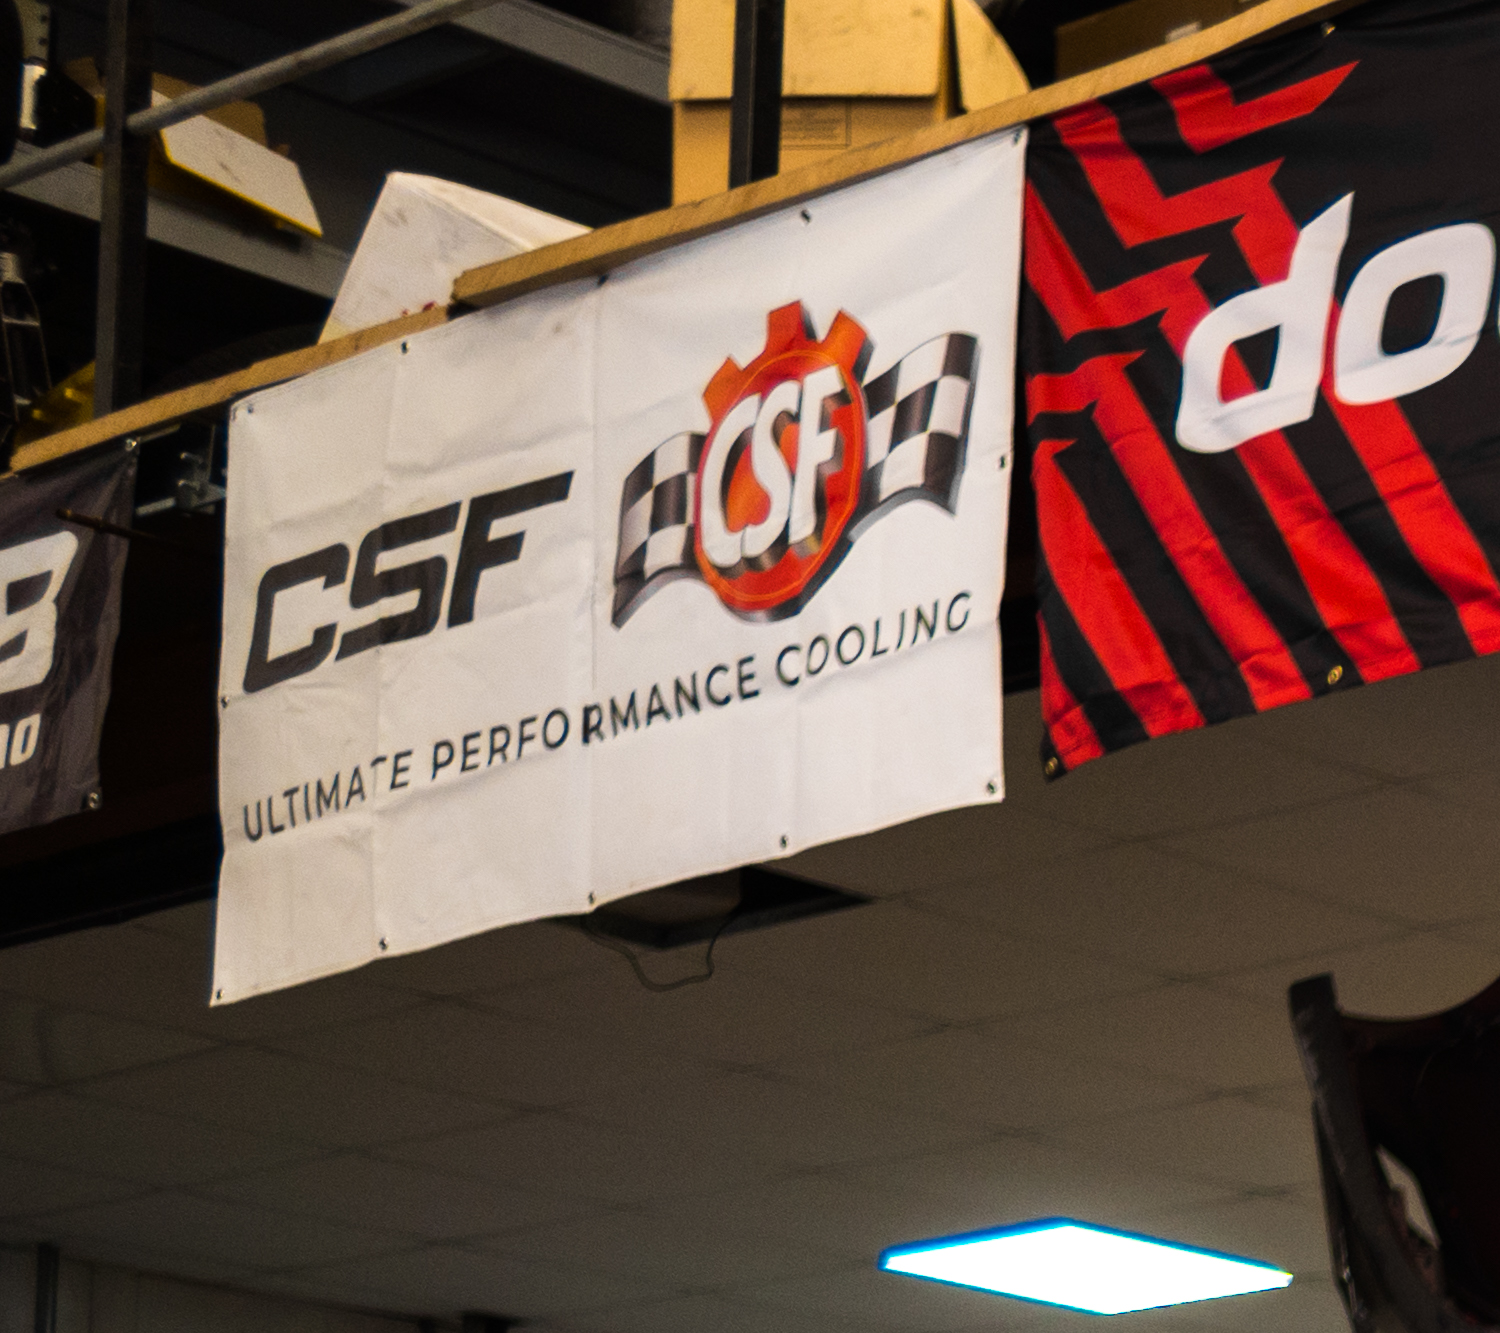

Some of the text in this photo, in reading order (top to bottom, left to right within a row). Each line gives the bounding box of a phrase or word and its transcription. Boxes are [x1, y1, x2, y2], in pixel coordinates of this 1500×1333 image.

[698, 362, 846, 571] CSF
[241, 470, 575, 696] CSF
[431, 653, 761, 781] PERFORMANCE
[775, 590, 972, 687] COOLING
